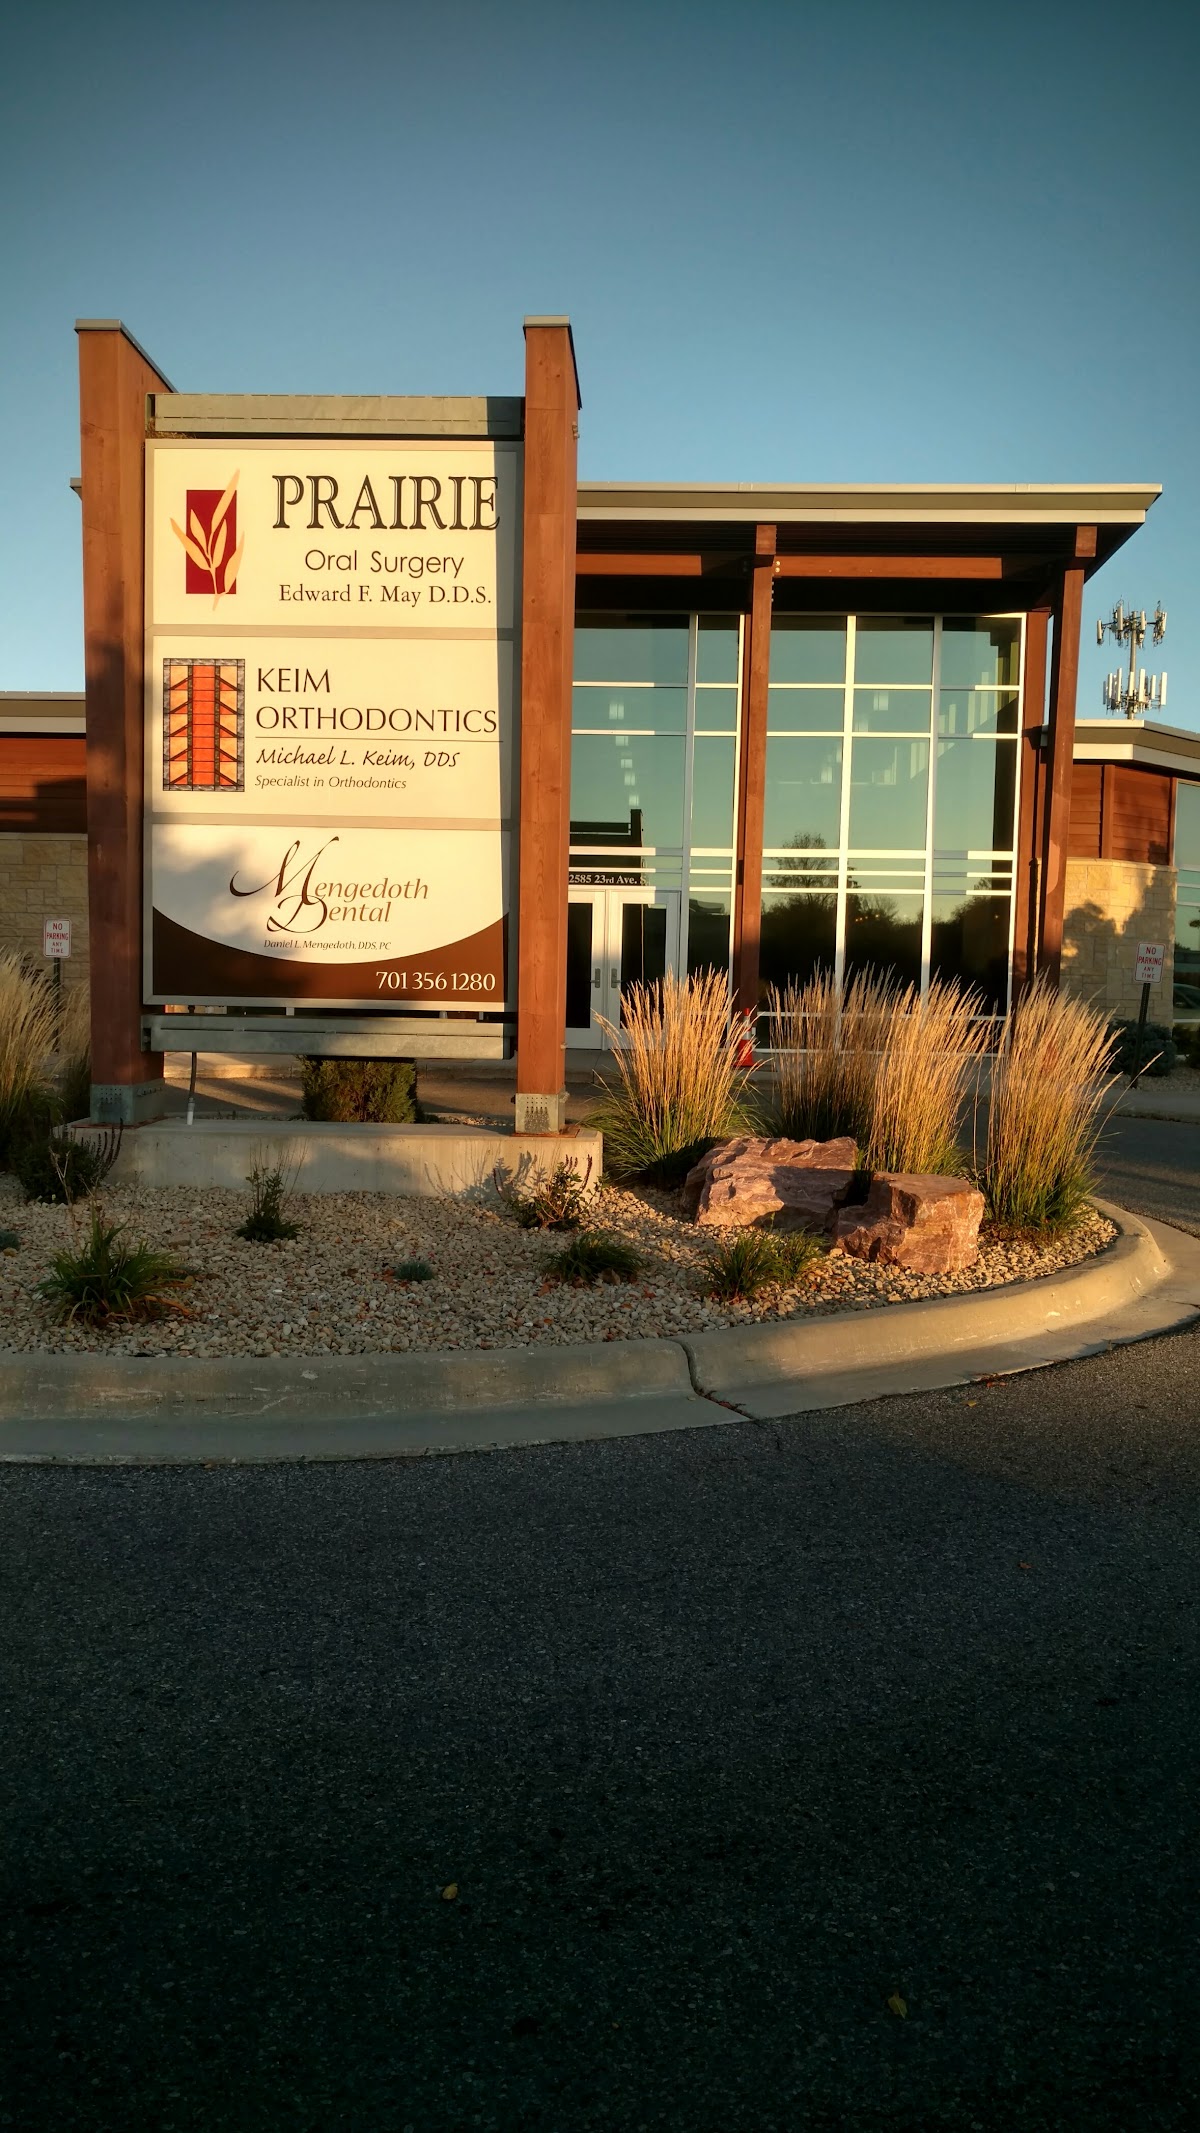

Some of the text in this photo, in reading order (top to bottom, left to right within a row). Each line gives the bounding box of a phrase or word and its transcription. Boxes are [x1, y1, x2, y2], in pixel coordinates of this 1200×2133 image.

[272, 475, 500, 531] PRAIRIE
[305, 549, 465, 579] Oral Surgery
[278, 584, 492, 608] Edward F. May D.D.S.
[257, 668, 331, 693] KEIM
[255, 706, 497, 733] ORTHODONTICS
[256, 745, 461, 770] Michael L. Keim, DDS
[254, 774, 407, 789] Specialist in Orthodontics
[229, 836, 429, 906] Mengedoth
[569, 874, 592, 884] 2585
[594, 874, 615, 884] 23rd
[616, 875, 638, 884] Ave.
[266, 894, 392, 933] Dental
[46, 932, 69, 940] PARKING
[52, 923, 63, 931] NO
[263, 939, 293, 949] Daniel
[294, 940, 302, 949] L.
[378, 941, 392, 950] PC
[1145, 946, 1157, 955] NO
[1137, 956, 1162, 965] PARKING
[375, 971, 496, 991] 701 356 1280
